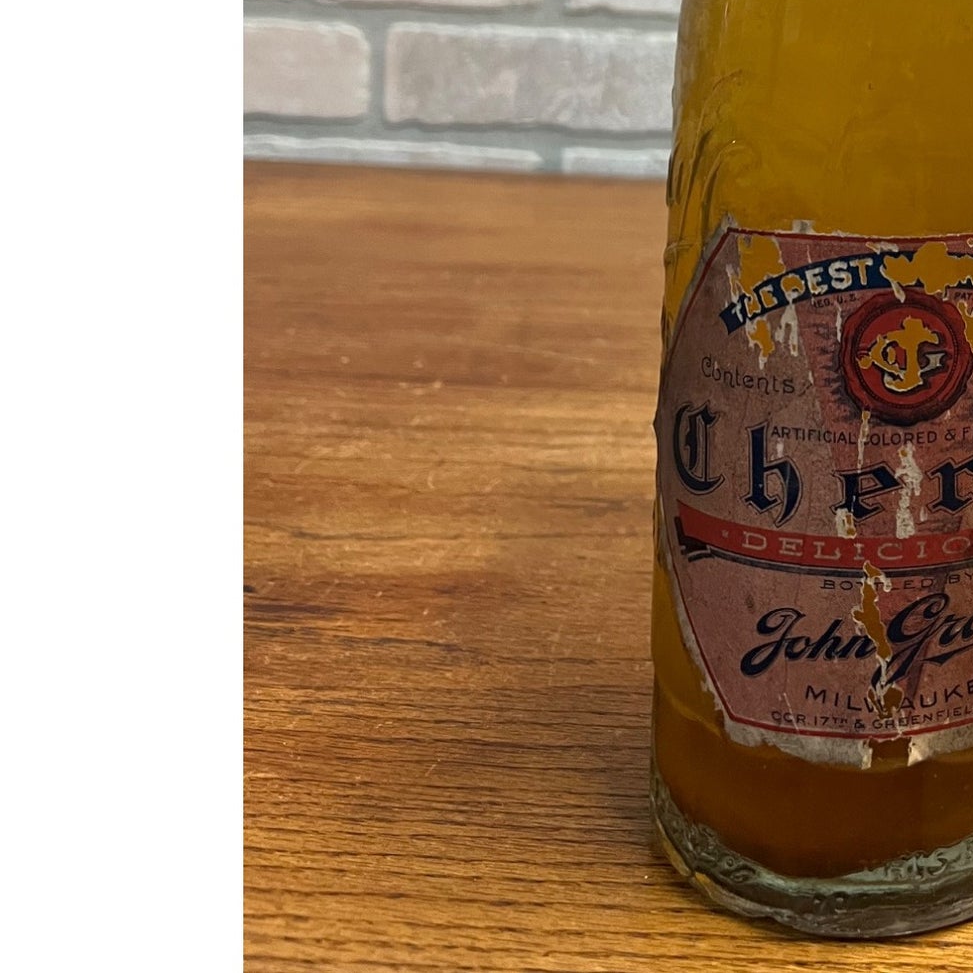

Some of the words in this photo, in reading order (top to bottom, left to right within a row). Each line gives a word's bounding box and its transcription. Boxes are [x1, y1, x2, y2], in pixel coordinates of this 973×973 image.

[701, 353, 796, 396] Contents
[770, 426, 858, 445] ARTIFICIAL
[944, 428, 957, 442] &
[738, 605, 878, 679] John
